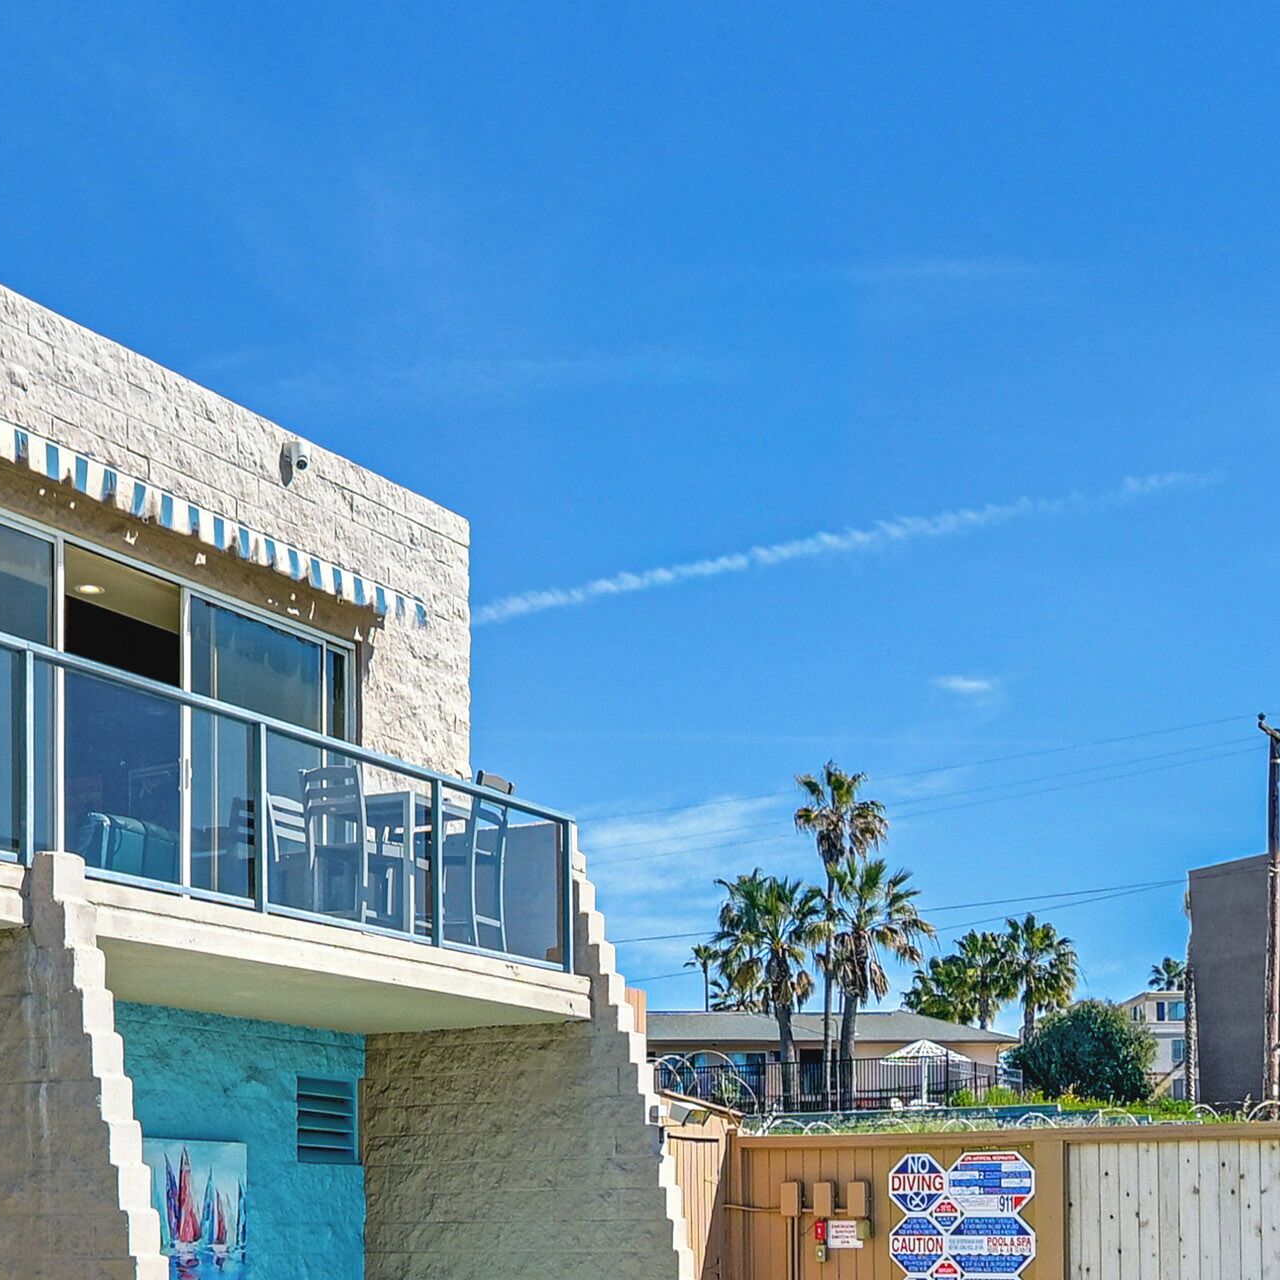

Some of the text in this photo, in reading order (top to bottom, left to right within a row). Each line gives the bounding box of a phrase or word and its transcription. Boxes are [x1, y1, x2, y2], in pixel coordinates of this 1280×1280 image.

[908, 1156, 930, 1174] NO
[892, 1175, 944, 1191] DIVING
[999, 1195, 1013, 1213] 911
[891, 1237, 944, 1253] CAUTION
[987, 1237, 1008, 1246] POOL
[1010, 1237, 1015, 1246] &
[1017, 1237, 1032, 1246] SPA
